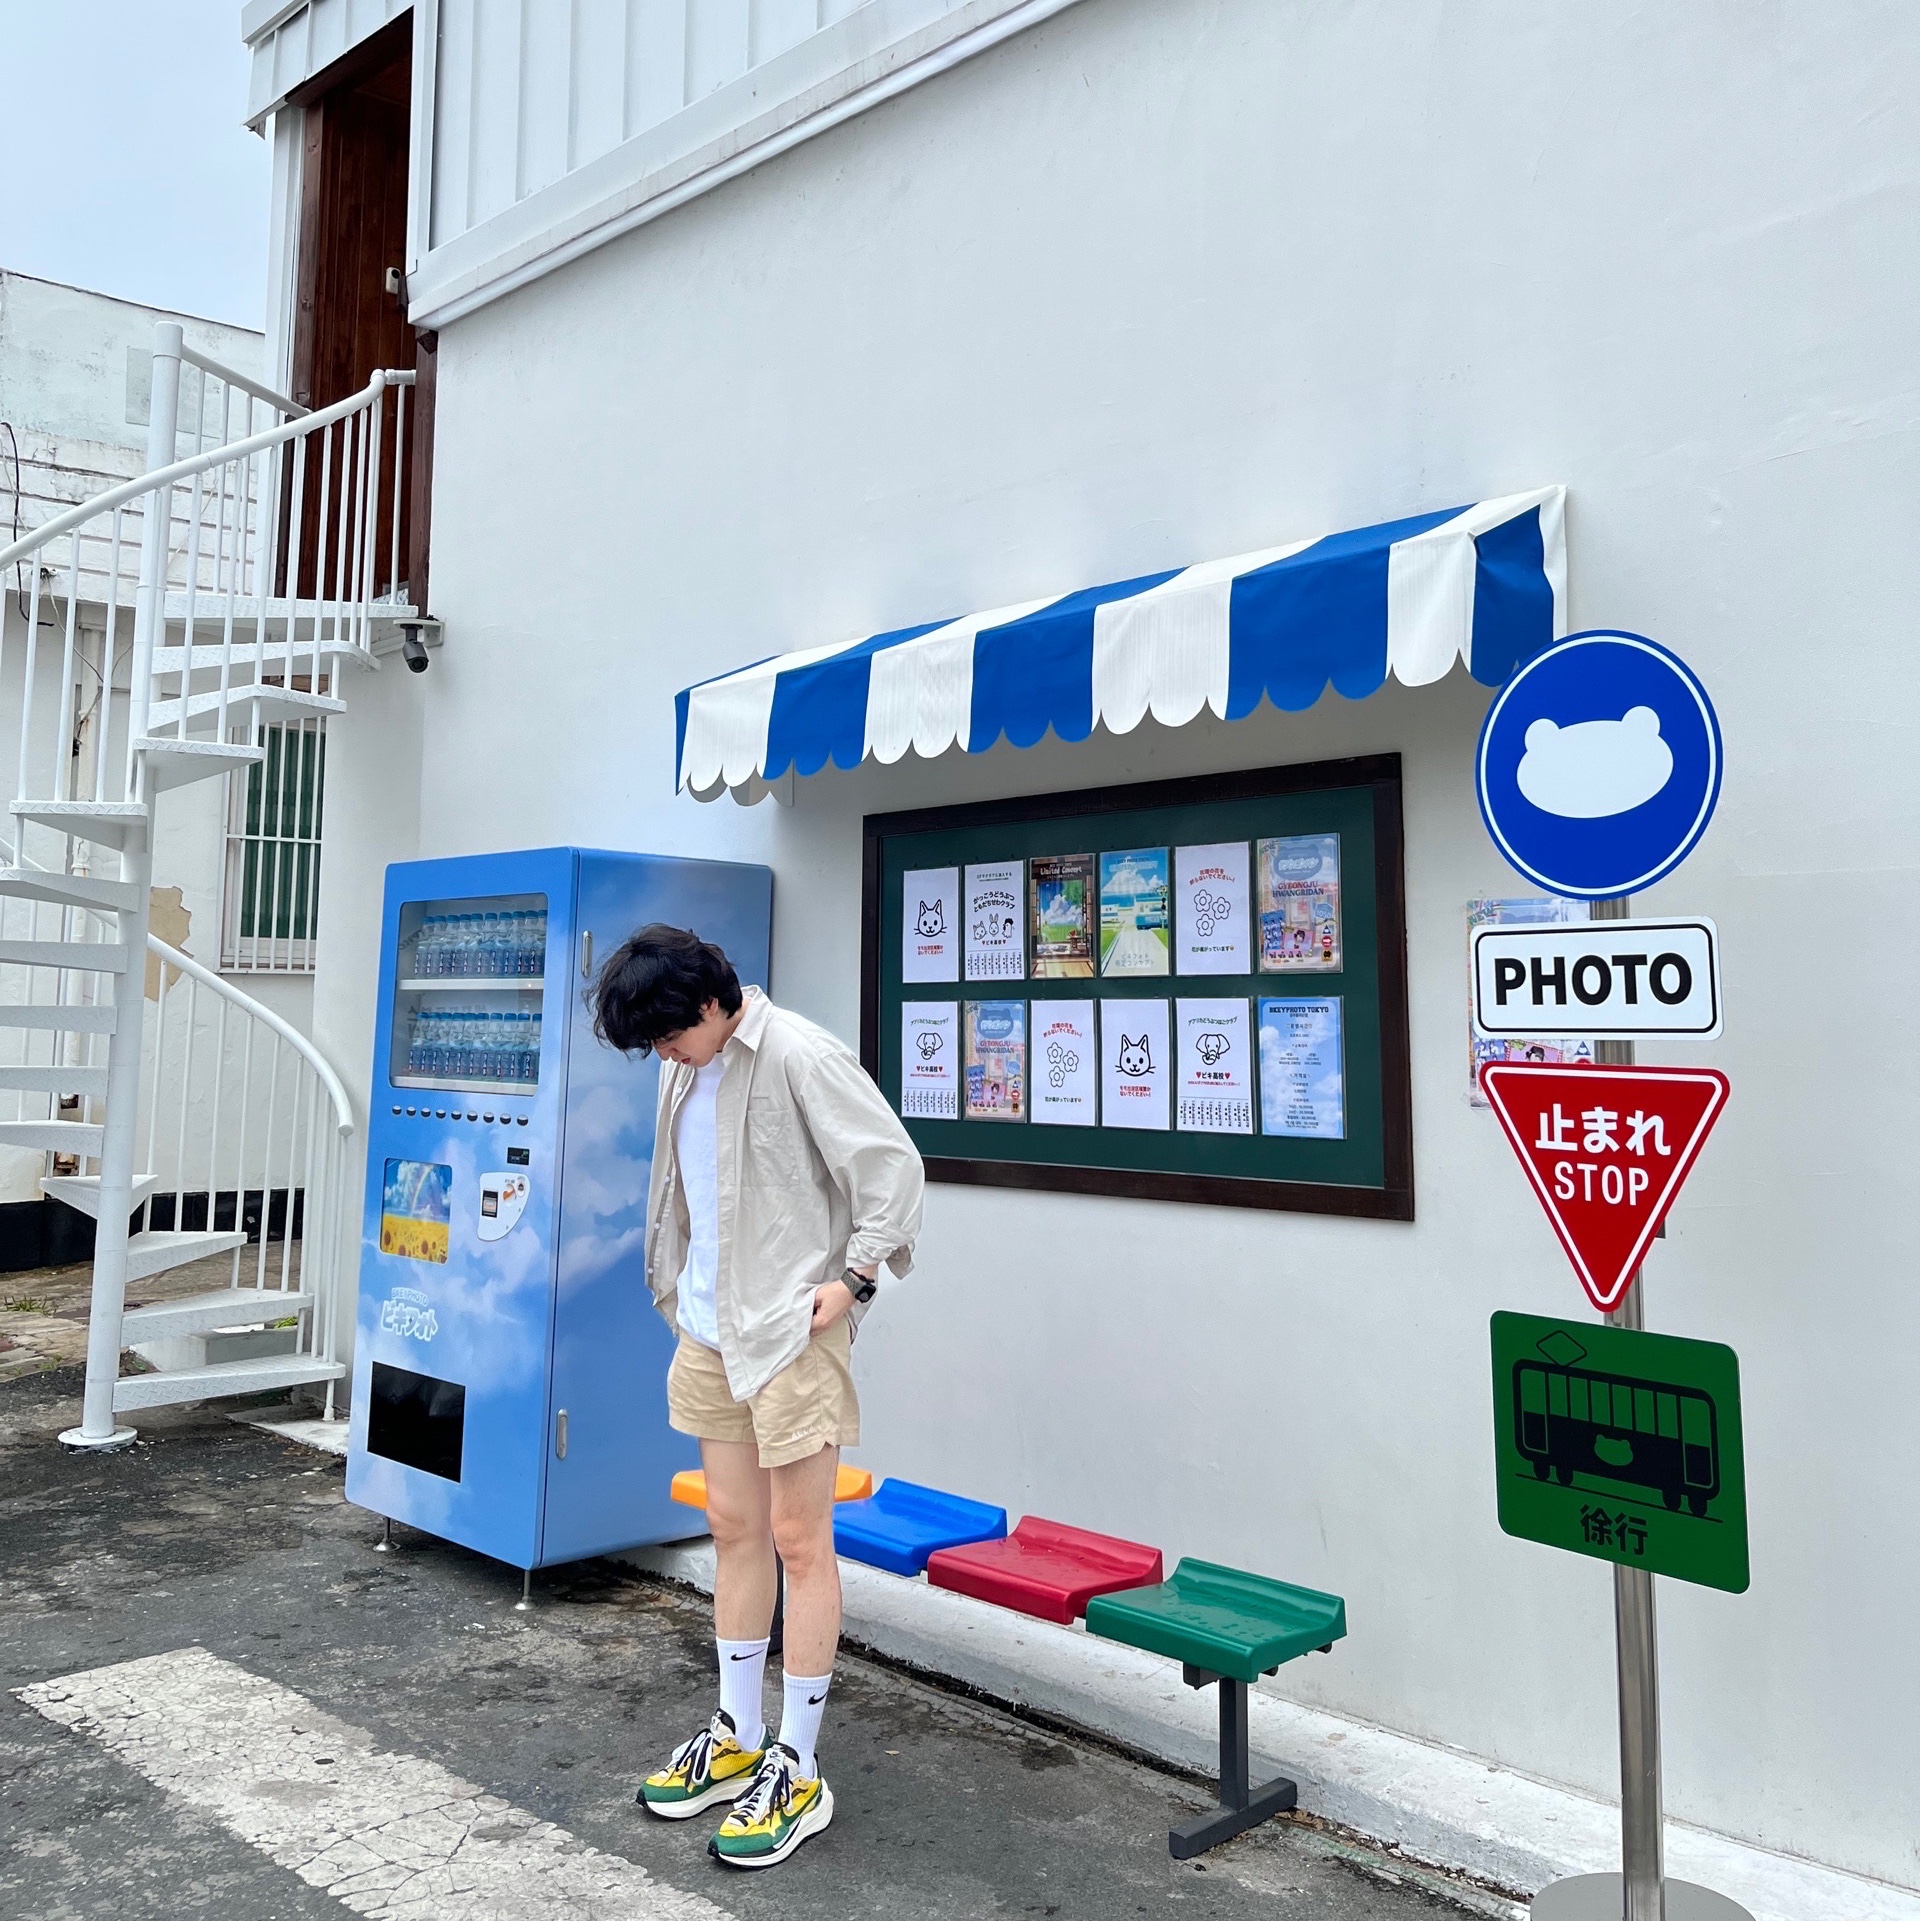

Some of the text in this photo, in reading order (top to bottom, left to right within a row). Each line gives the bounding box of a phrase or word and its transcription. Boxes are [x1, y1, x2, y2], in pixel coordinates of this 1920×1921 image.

[1272, 888, 1324, 897] HWANGRIDAN
[1278, 881, 1318, 890] GYEONGJU
[1494, 952, 1692, 1006] PHOTO
[1535, 1103, 1671, 1156] 止まれ
[1554, 1161, 1649, 1206] STOP
[1579, 1504, 1648, 1556] 徐行
